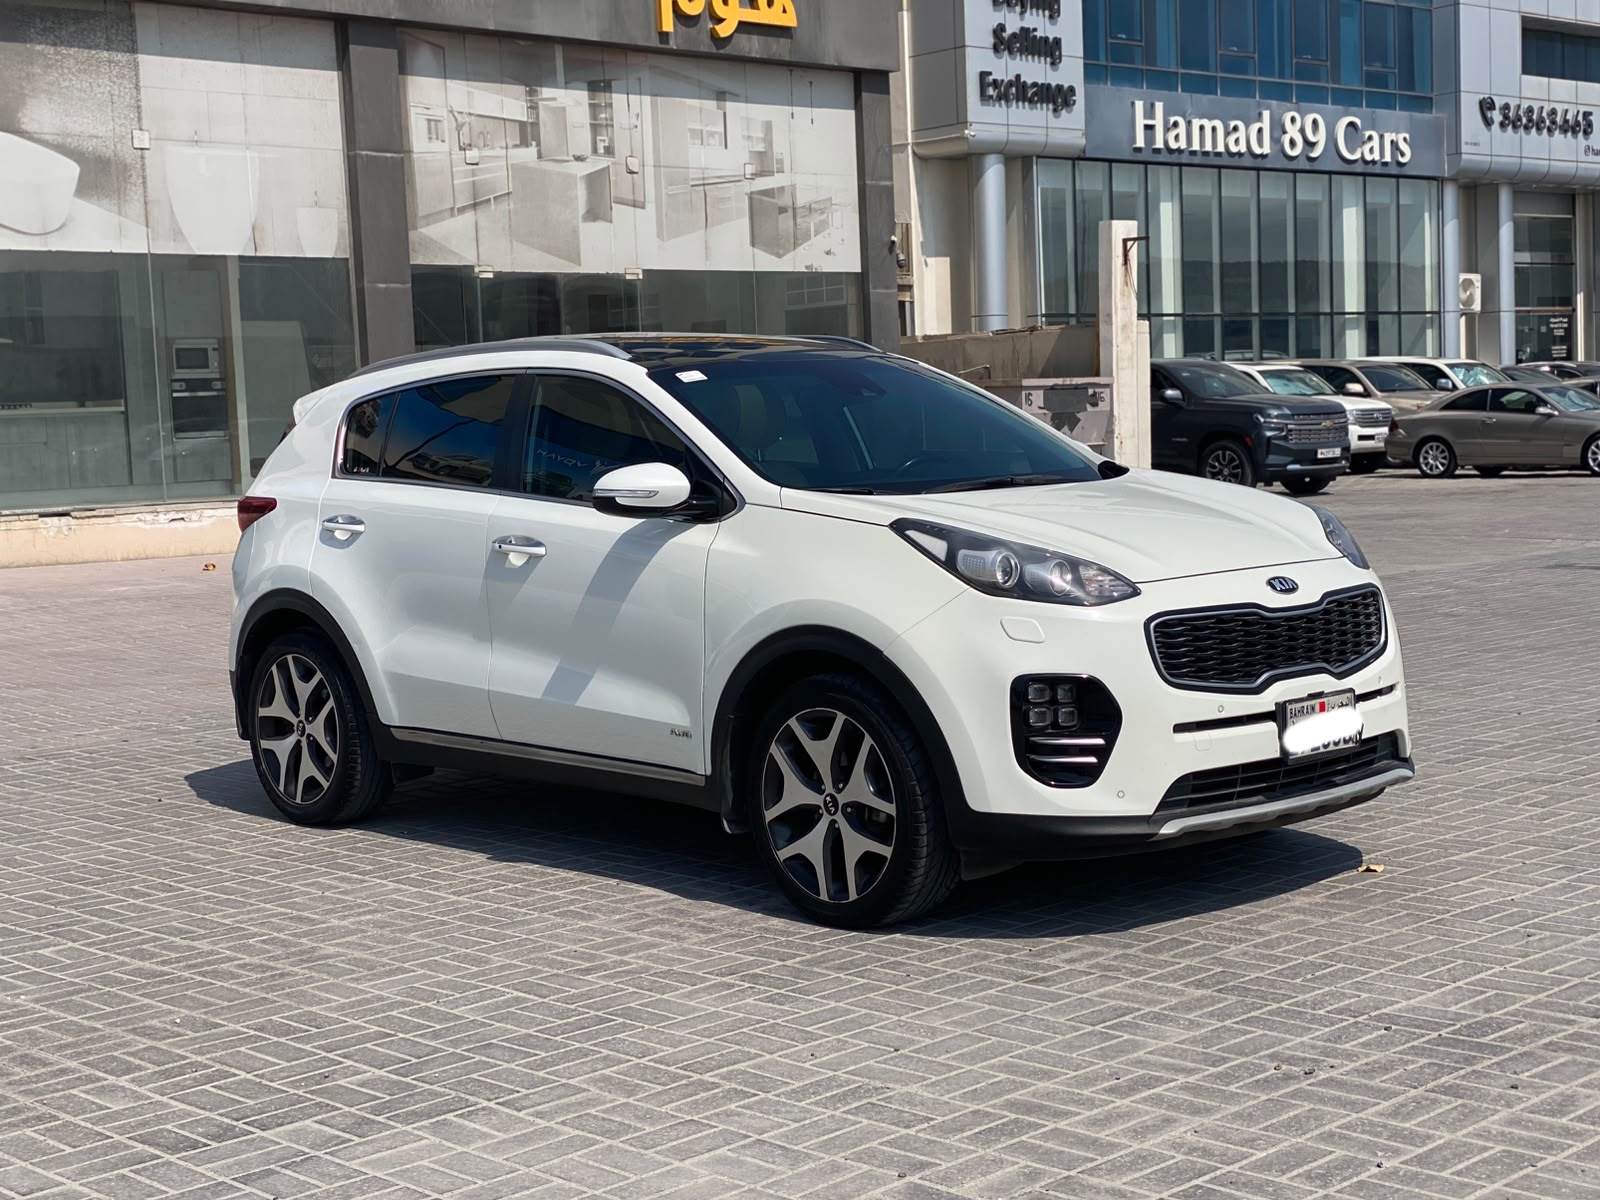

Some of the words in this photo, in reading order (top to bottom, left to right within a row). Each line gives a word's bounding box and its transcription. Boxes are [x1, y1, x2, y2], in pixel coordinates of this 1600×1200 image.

[992, 0, 1061, 19] yng
[992, 22, 1062, 66] Selling
[979, 70, 1076, 113] Exchange
[1132, 100, 1271, 156] Hamad
[1280, 111, 1326, 158] 89
[1335, 116, 1412, 164] Cars
[1584, 144, 1600, 157] @ha
[1289, 703, 1316, 719] BAHRAIN
